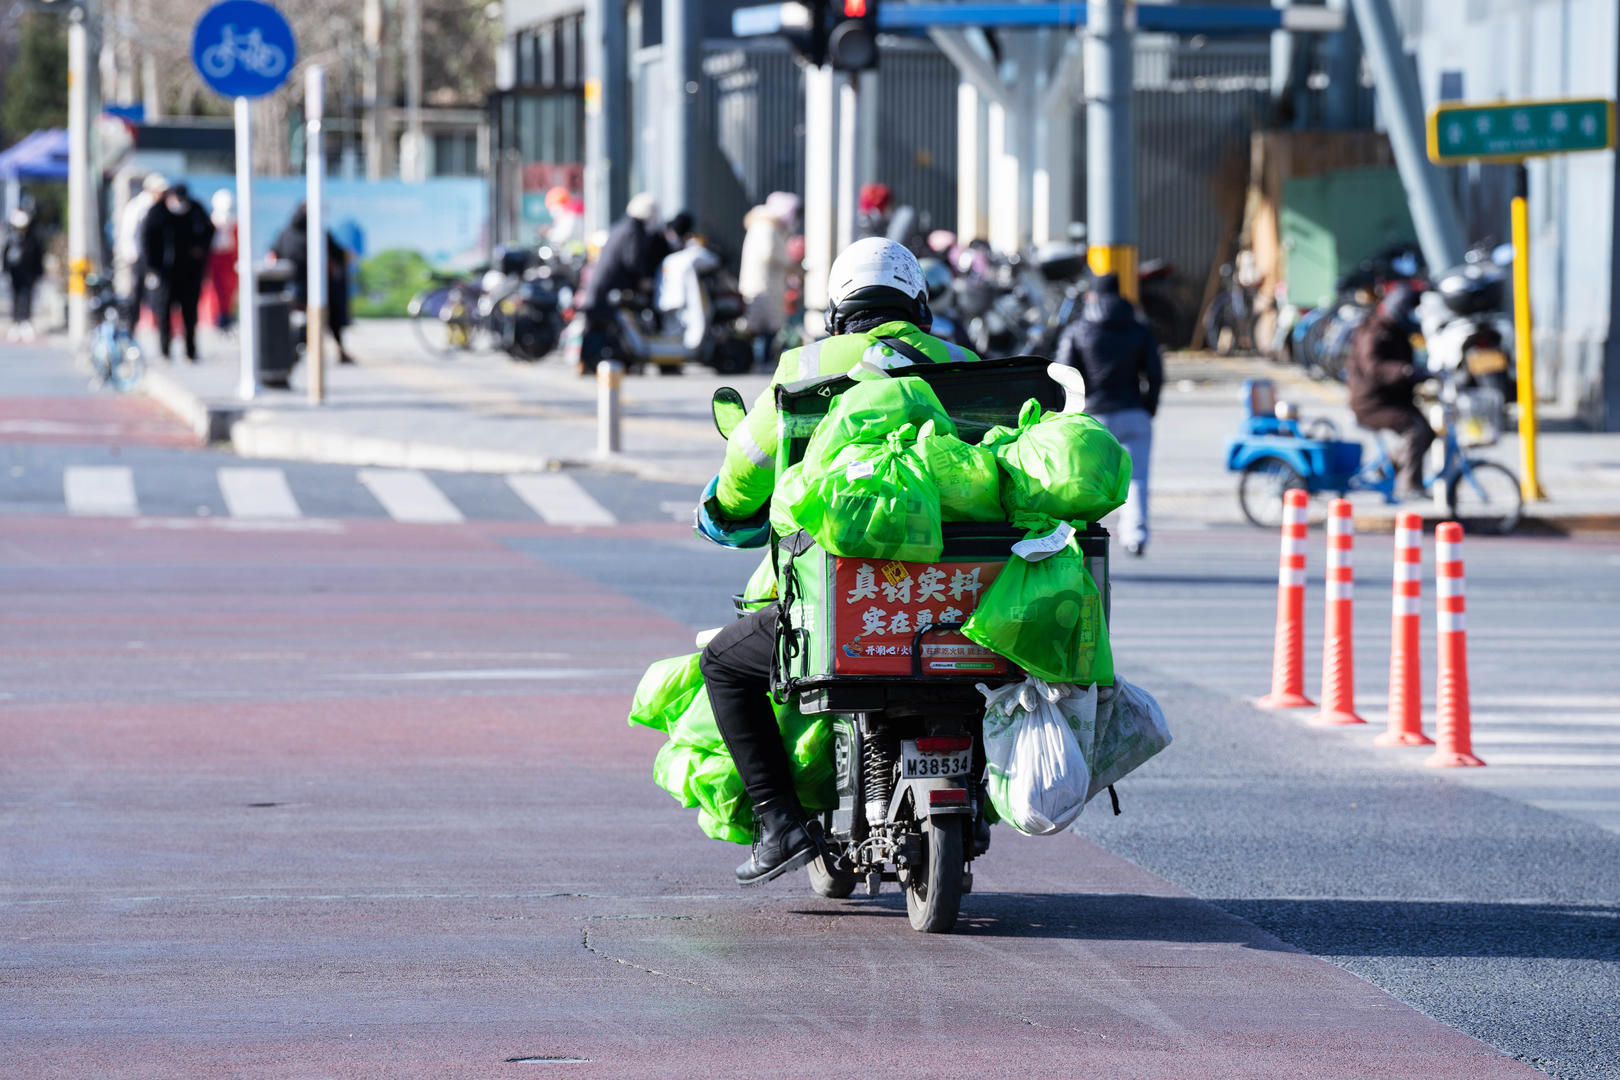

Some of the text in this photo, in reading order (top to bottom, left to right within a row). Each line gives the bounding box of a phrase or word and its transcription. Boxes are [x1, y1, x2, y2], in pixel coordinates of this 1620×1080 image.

[846, 562, 984, 605] 真材实料
[860, 606, 977, 637] 实在更实
[865, 645, 913, 656] 开涮吧!火
[907, 756, 968, 775] M38534
